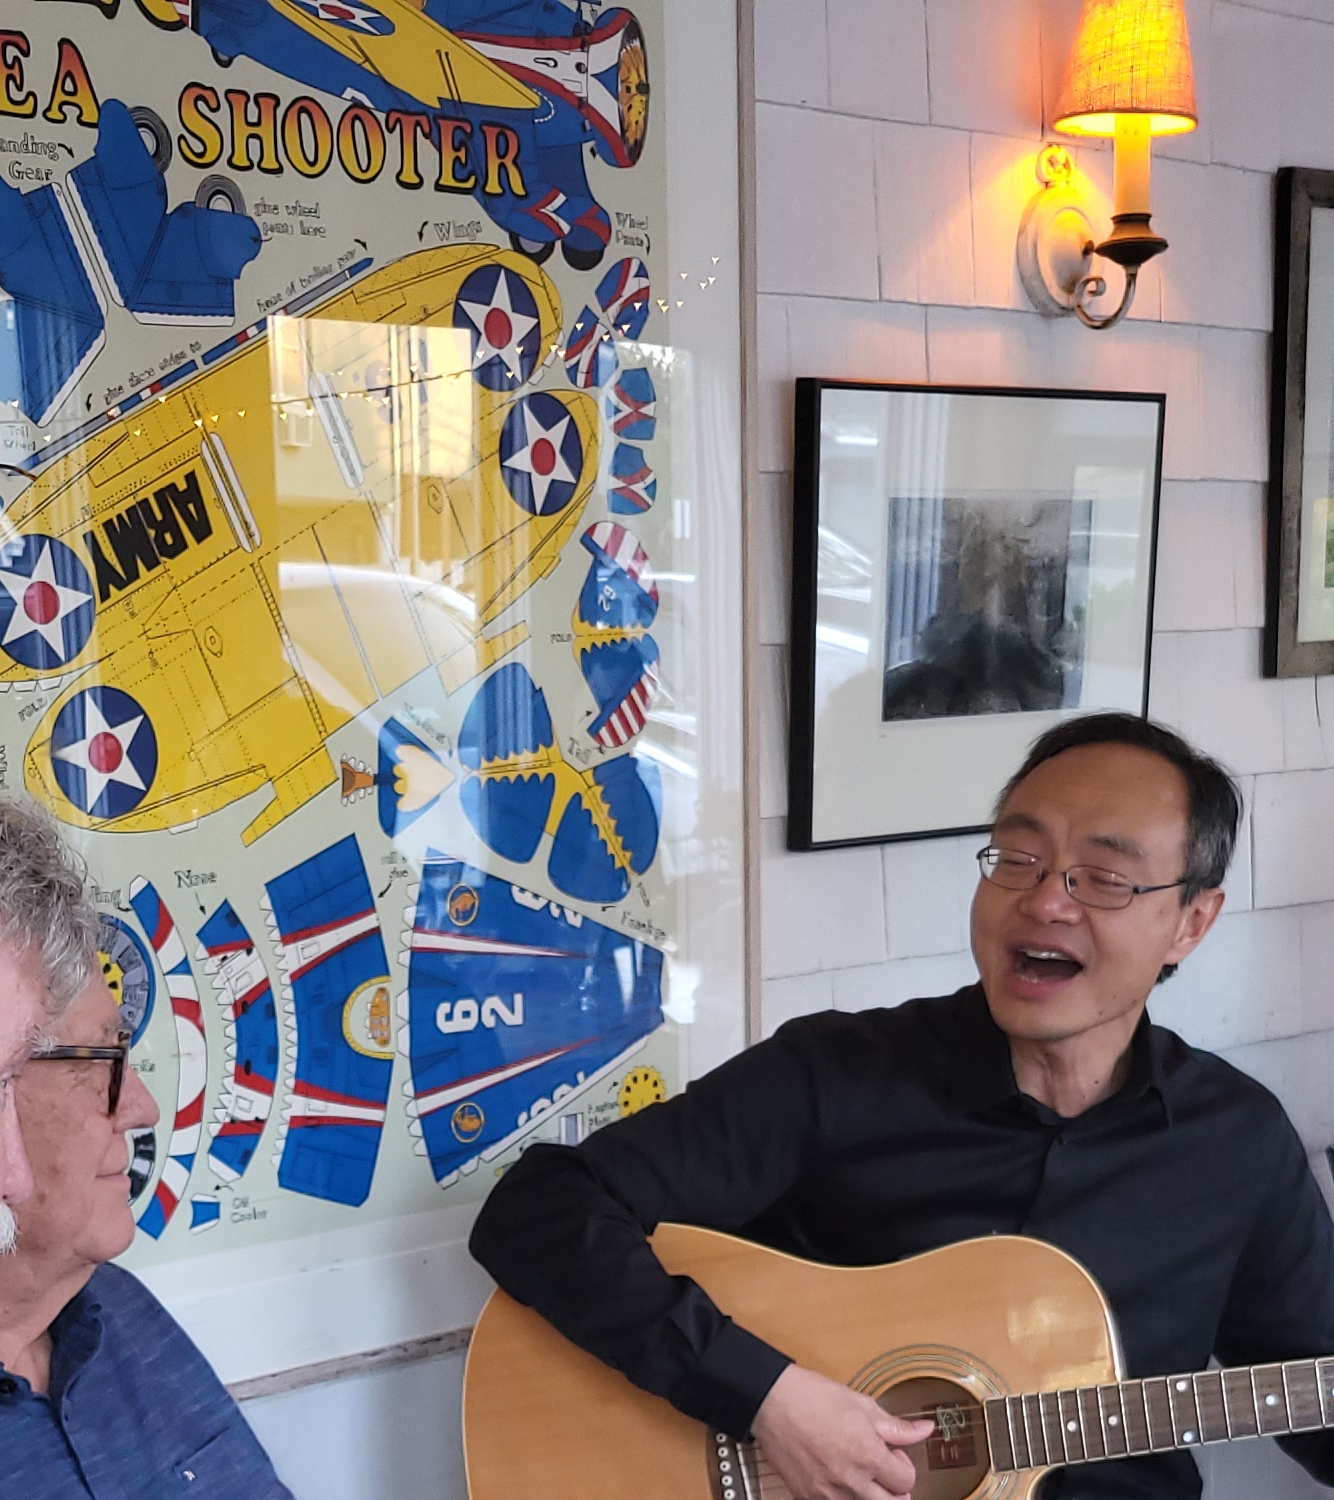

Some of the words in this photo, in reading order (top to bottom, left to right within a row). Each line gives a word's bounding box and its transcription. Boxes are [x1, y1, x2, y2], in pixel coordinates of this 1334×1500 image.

[177, 82, 528, 197] SHOOTER
[8, 160, 53, 181] Gear
[433, 219, 483, 242] Wings
[83, 469, 214, 605] ARMY
[18, 694, 49, 723] FOLD
[174, 869, 217, 889] Nose
[436, 993, 524, 1035] 62
